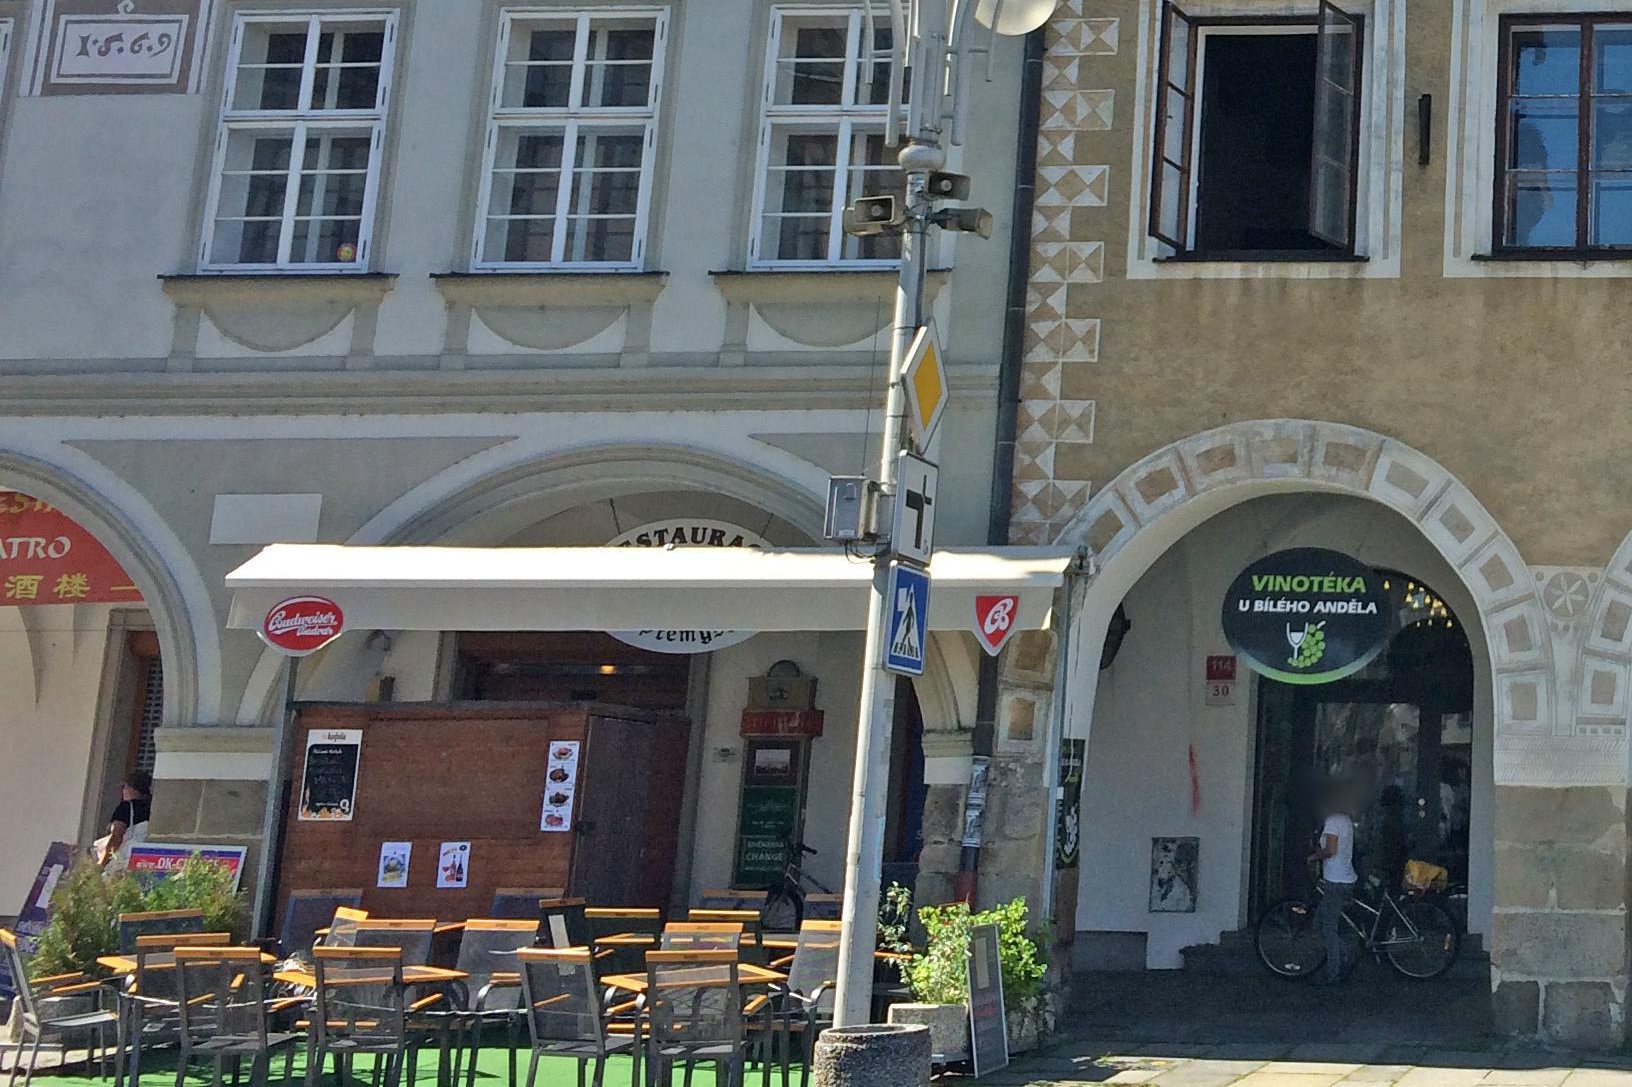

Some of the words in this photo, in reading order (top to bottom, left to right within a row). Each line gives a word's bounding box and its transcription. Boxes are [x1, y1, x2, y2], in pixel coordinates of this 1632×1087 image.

[1251, 572, 1367, 594] VINOTÉKA
[1238, 600, 1250, 612] U
[1253, 597, 1311, 613] BÍLÉHO
[1313, 598, 1378, 614] ANDĚLA
[268, 610, 337, 632] Budweiser
[1212, 685, 1230, 697] 30
